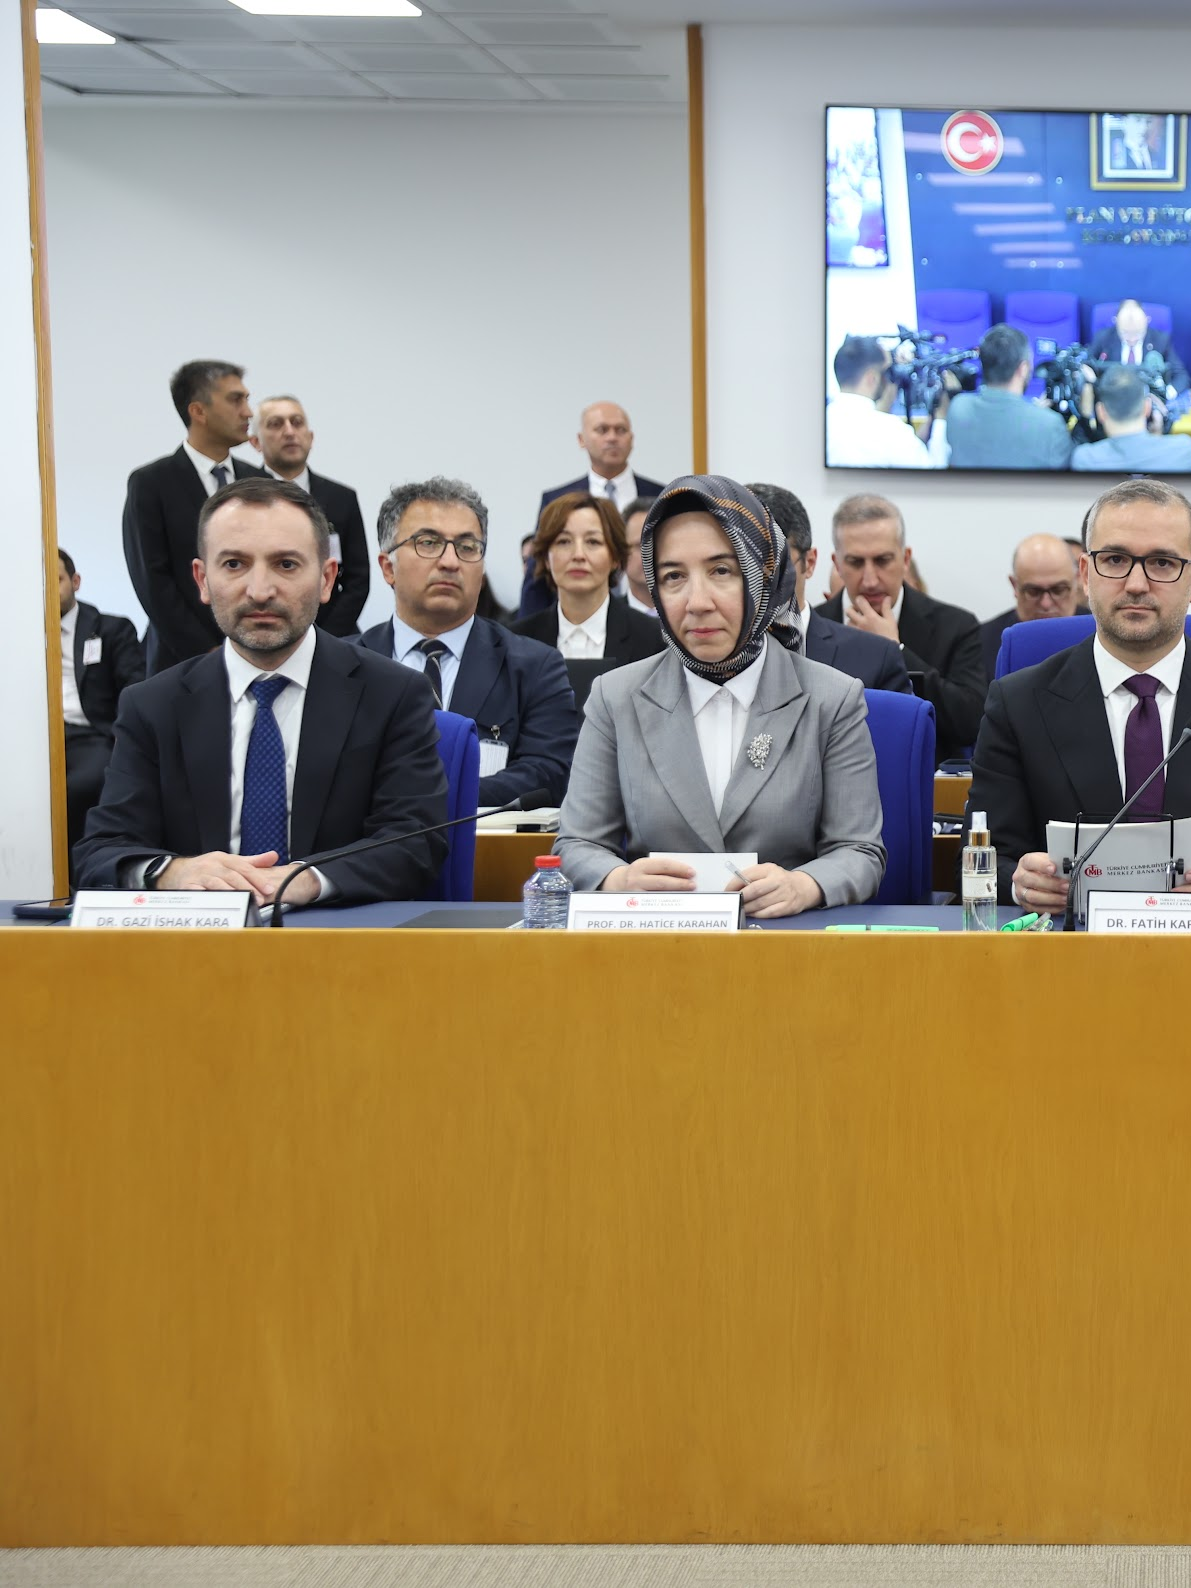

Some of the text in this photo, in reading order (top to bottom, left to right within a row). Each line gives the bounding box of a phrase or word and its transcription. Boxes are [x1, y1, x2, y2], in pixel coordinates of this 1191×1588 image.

[96, 914, 230, 927] DR. GAZİ İSHAK KARA
[587, 918, 728, 929] PROF. DR. HATİCE KARAHAN
[1106, 918, 1127, 928] DR.
[1131, 917, 1166, 929] FATİH
